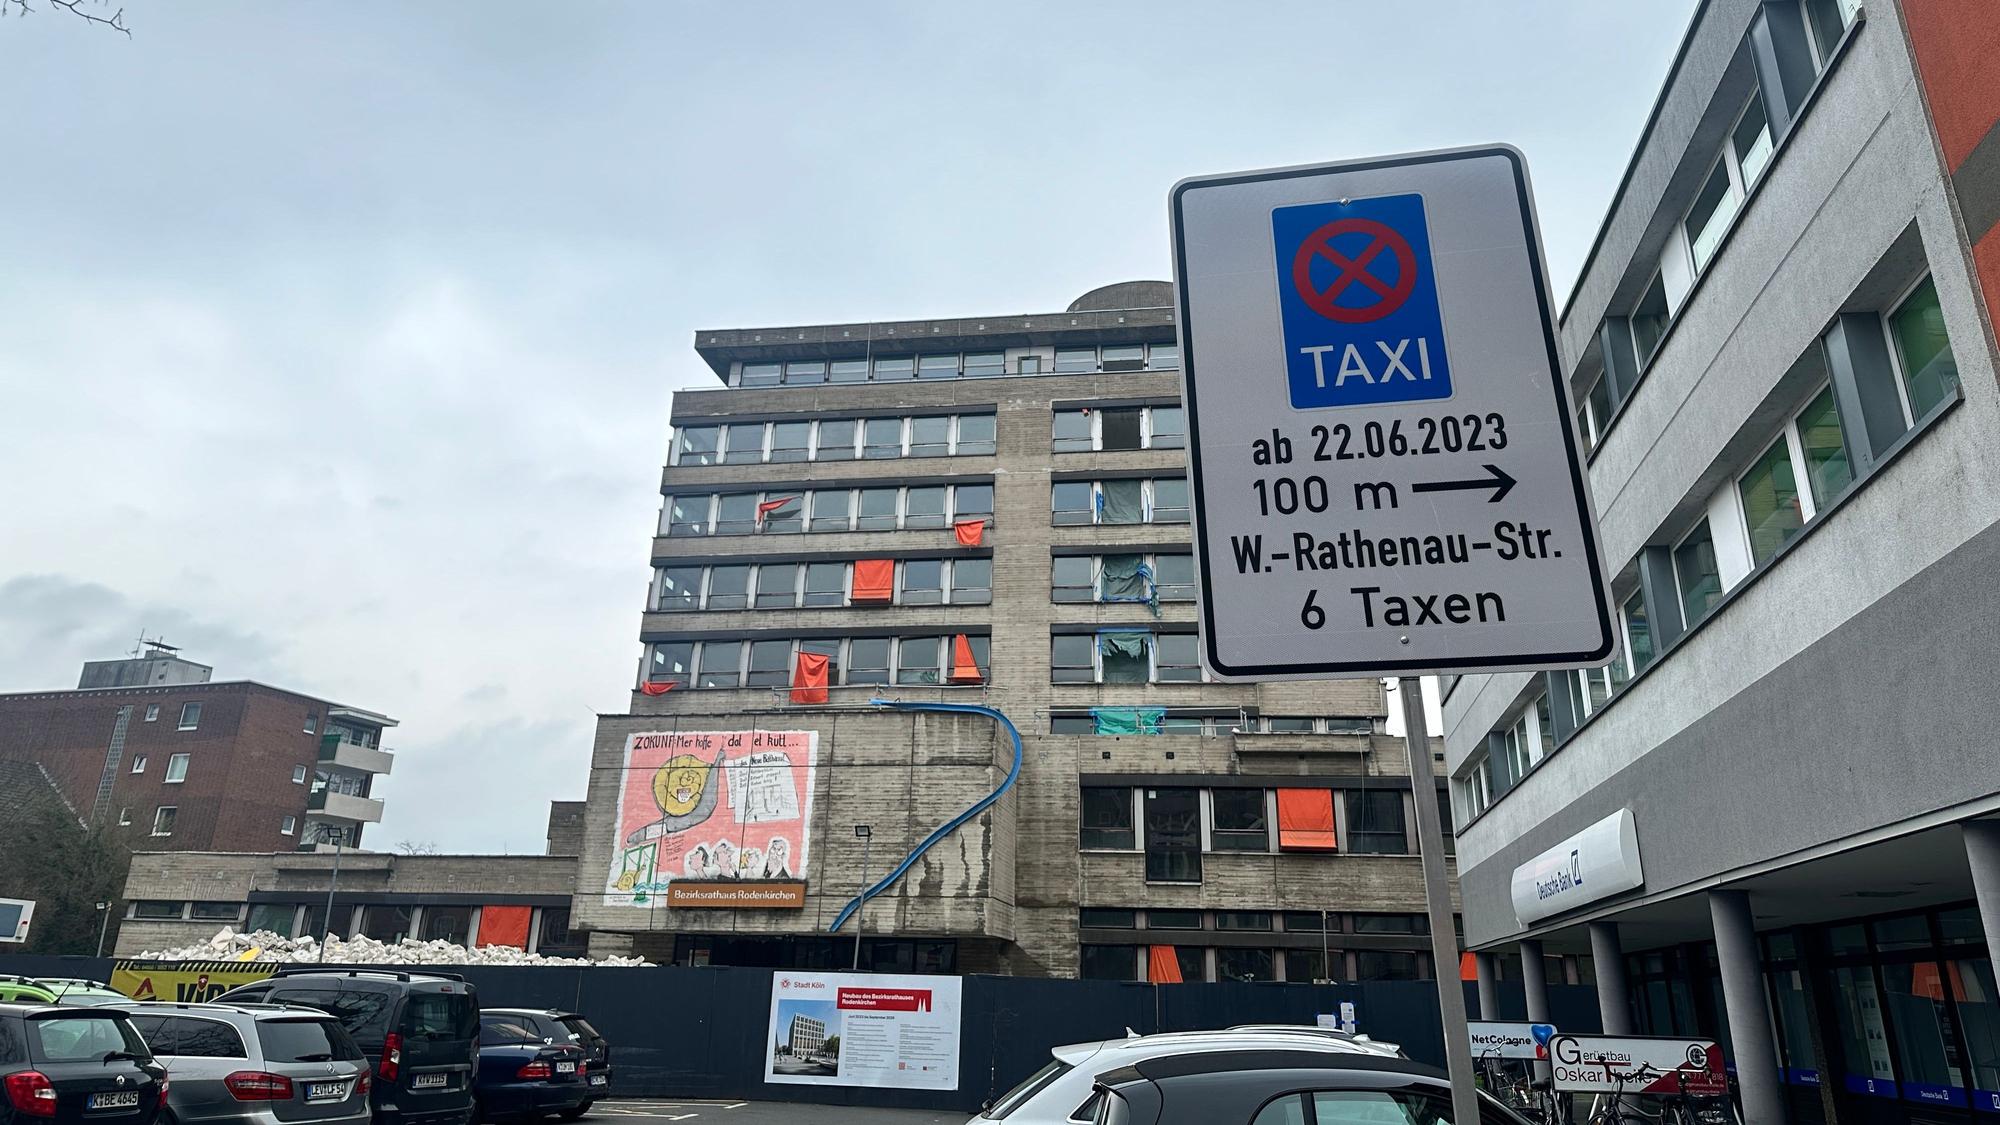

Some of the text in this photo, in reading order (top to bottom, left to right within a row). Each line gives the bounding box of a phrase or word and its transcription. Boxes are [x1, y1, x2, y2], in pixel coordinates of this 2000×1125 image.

[1301, 337, 1432, 388] TAXI
[1252, 413, 1508, 466] ab 22.06.2023
[1253, 475, 1398, 516] 100 m
[1231, 521, 1562, 574] W.-Rathenau-Str.
[1301, 586, 1505, 630] 6 Taxen
[674, 889, 796, 899] Bezirksrathaus Rodenkirchen
[1537, 868, 1573, 900] Deutsche Bank
[794, 981, 825, 989] Stadt Köln
[842, 992, 862, 1000] Neubau
[872, 993, 914, 1001] Bezirksrathauses
[842, 998, 876, 1006] Rodenkirchen
[1471, 1034, 1532, 1047] NetCologne
[1556, 1036, 1632, 1065] Gerüstbau
[1555, 1066, 1603, 1083] Oskar
[93, 1094, 99, 1107] K
[104, 1093, 116, 1106] BE
